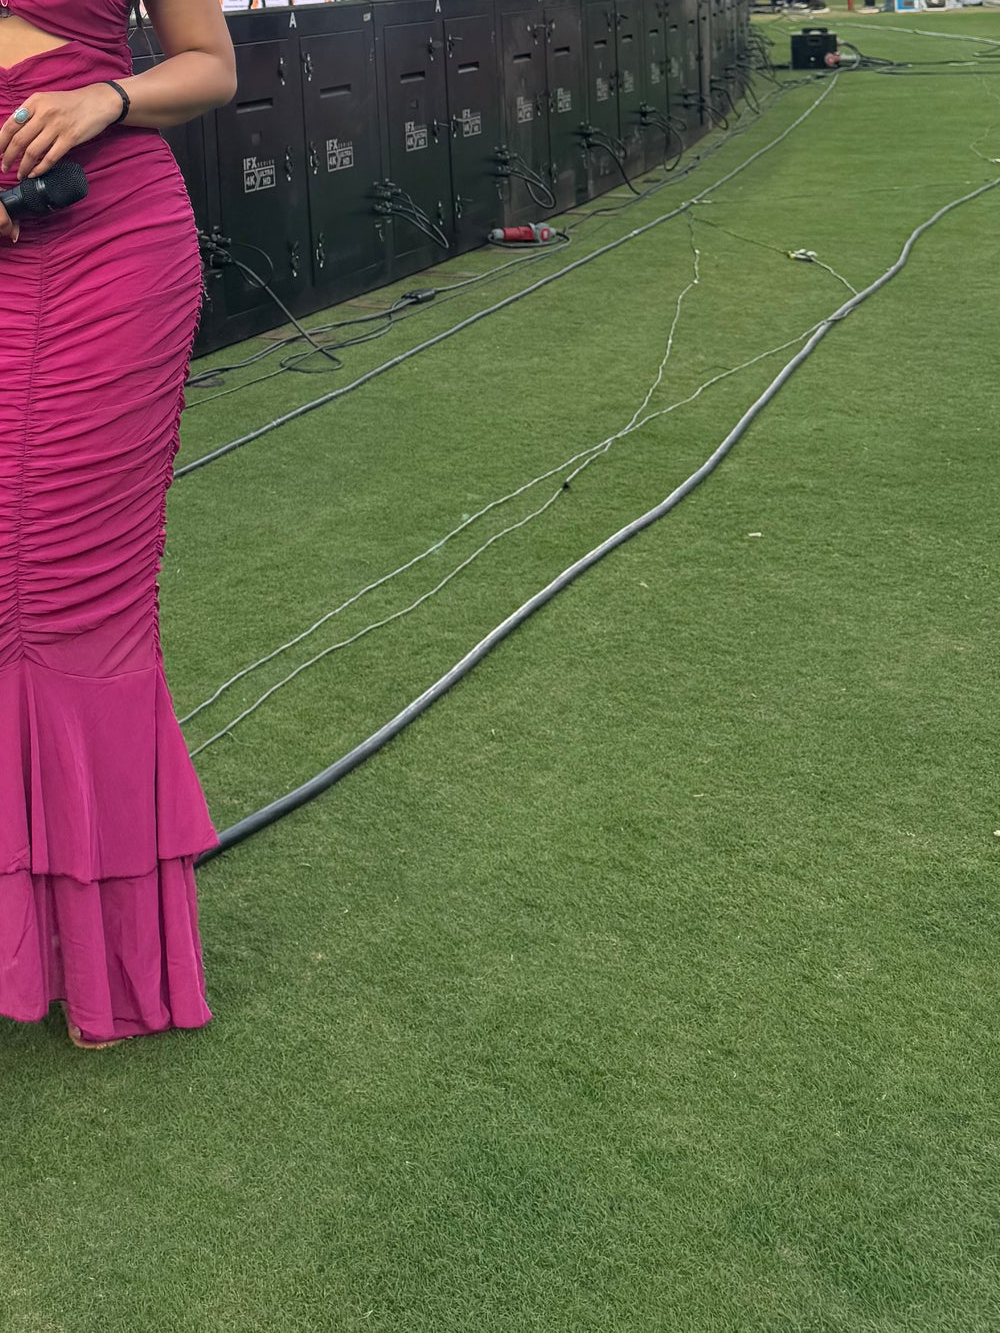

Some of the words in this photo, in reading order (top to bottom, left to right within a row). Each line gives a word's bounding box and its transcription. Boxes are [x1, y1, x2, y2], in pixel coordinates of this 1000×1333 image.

[289, 12, 297, 28] A
[326, 138, 338, 151] IFX
[243, 156, 257, 171] IFX
[246, 174, 255, 186] 4K
